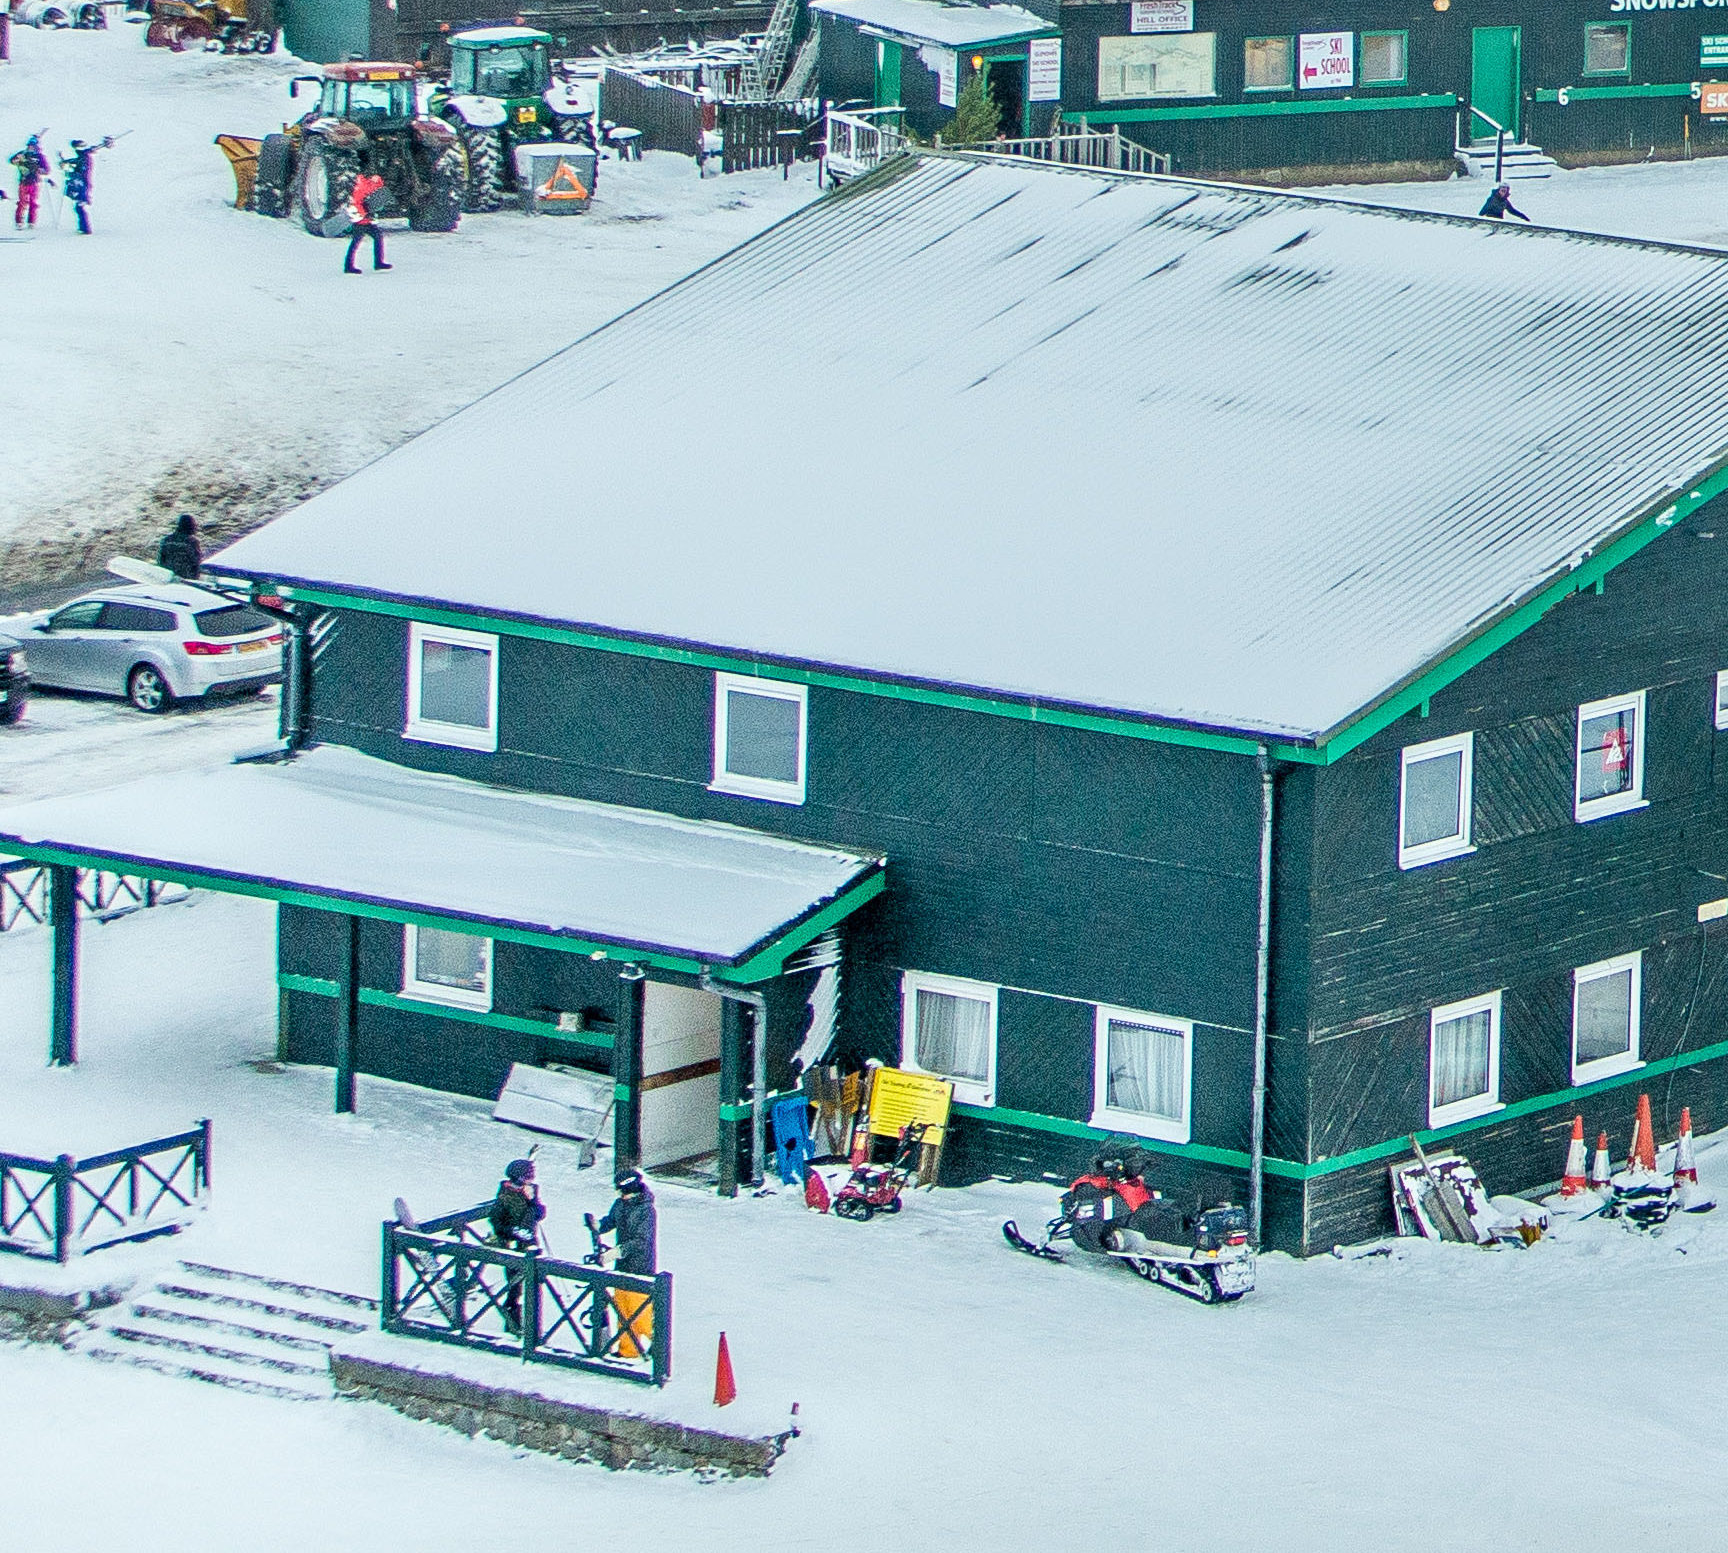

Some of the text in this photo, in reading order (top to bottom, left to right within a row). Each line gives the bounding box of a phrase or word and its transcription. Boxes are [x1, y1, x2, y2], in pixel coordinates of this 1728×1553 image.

[1330, 38, 1343, 55] SKI
[1701, 36, 1714, 46] SKI
[1321, 57, 1351, 75] SCHOOL
[1557, 87, 1570, 106] 6
[1690, 81, 1702, 100] 5
